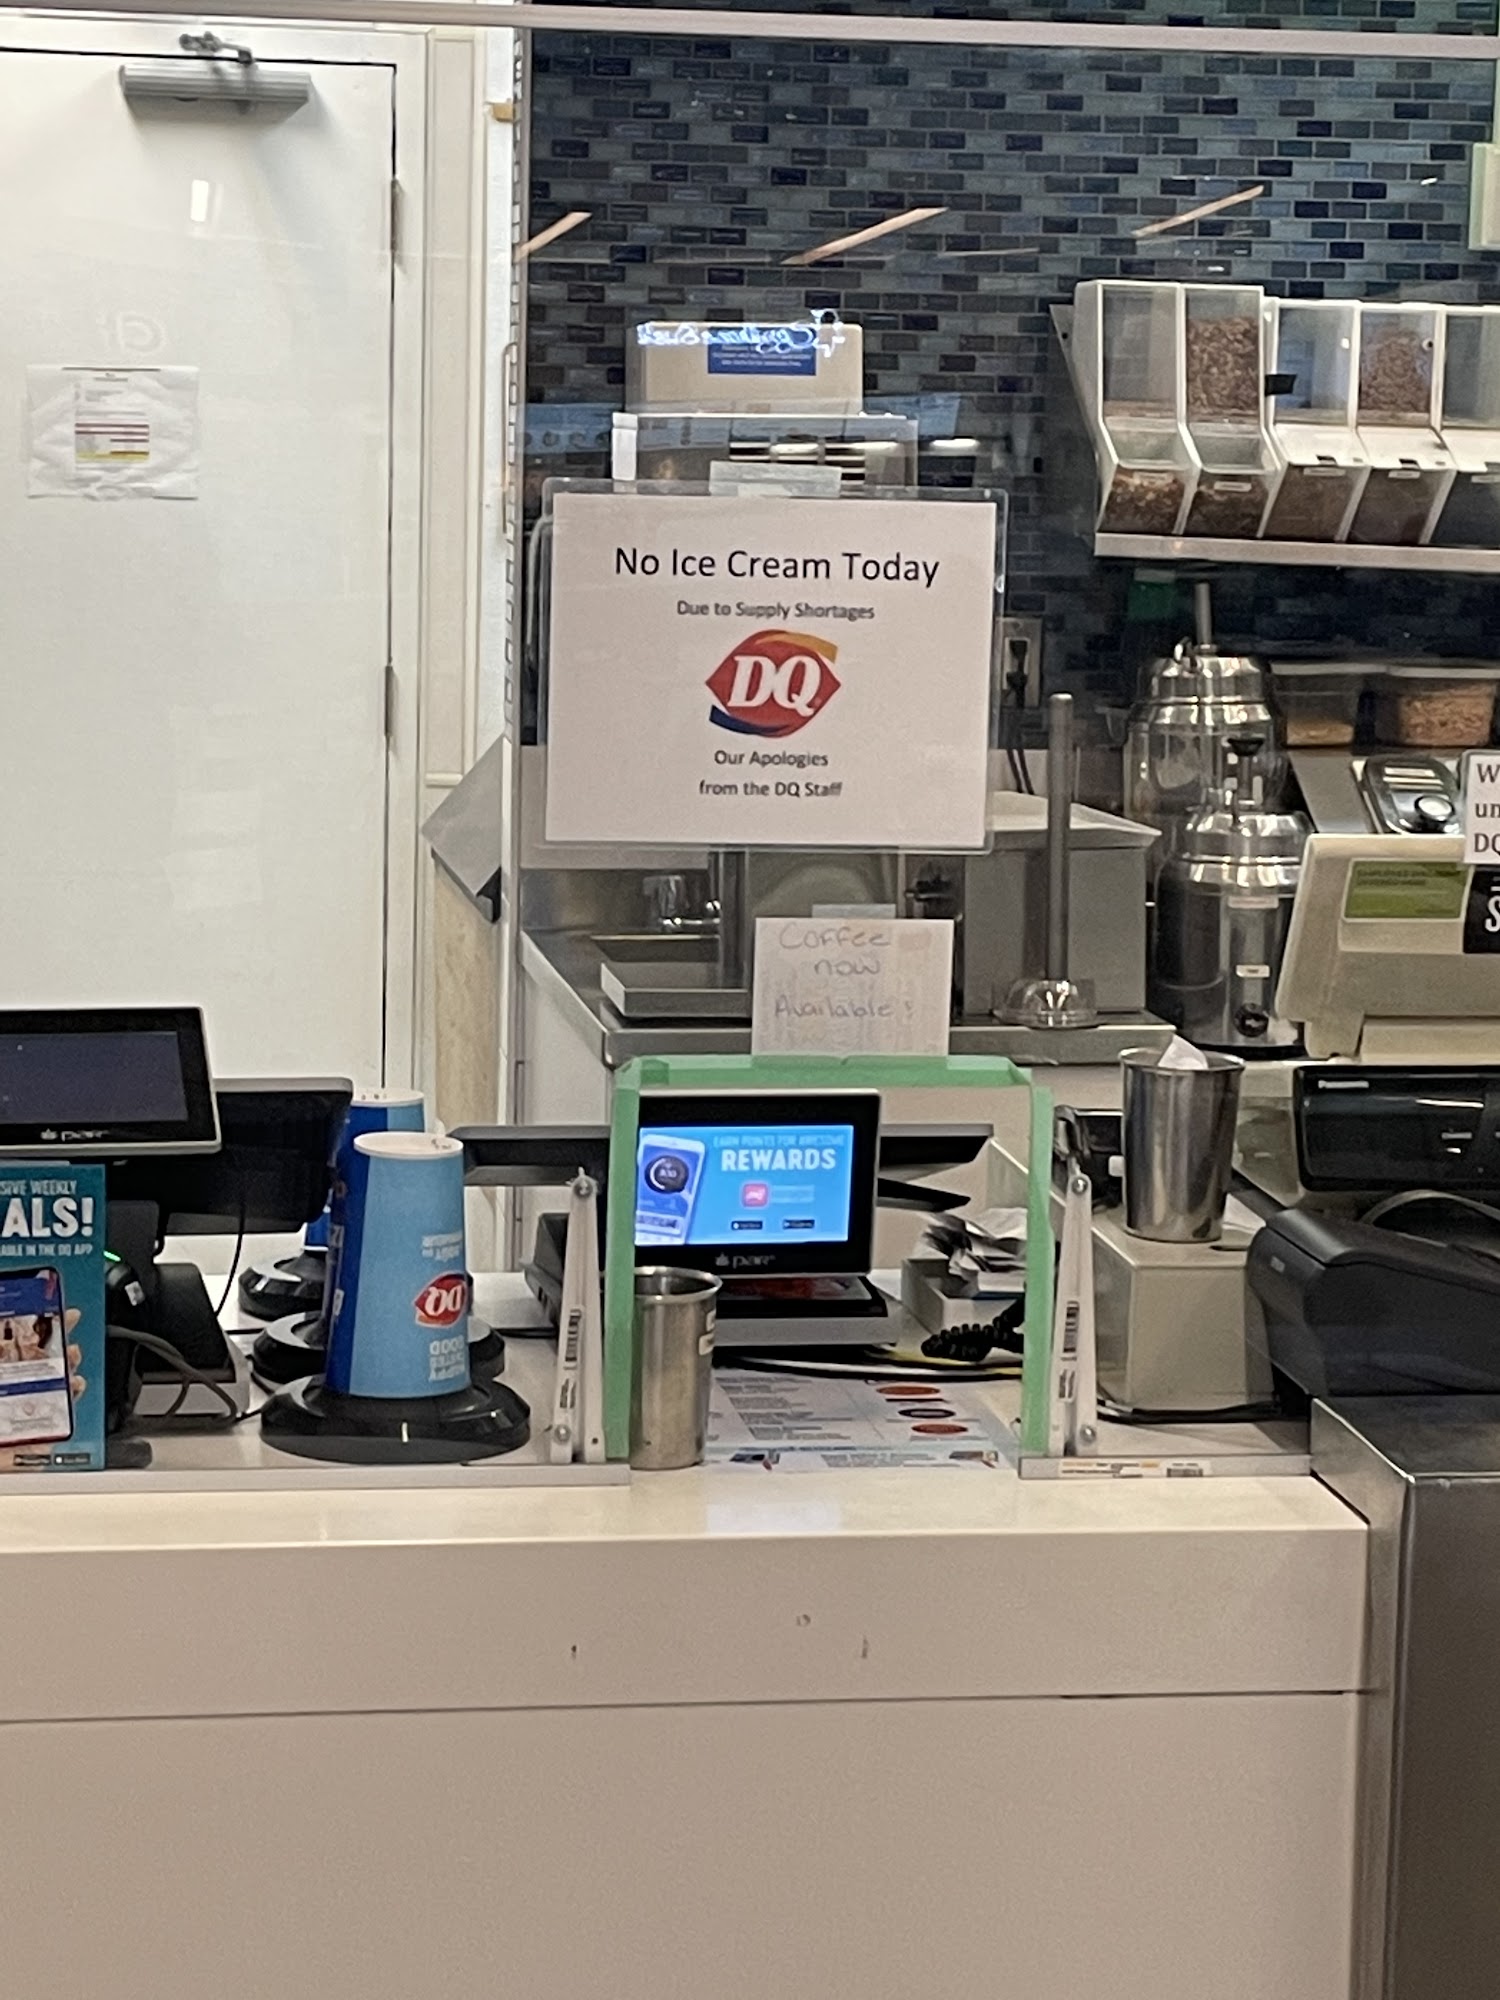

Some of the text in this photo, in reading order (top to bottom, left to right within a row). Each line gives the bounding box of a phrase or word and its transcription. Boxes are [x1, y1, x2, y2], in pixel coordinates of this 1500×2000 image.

[615, 547, 940, 588] No Ice Cream Today
[677, 600, 875, 622] Due to Supply Shortages
[726, 654, 822, 717] DQ
[714, 750, 829, 768] Our Apologies
[699, 780, 843, 798] from the DQ Staff
[779, 922, 891, 949] Coffee
[814, 958, 881, 976] now
[721, 1148, 836, 1171] REWARDS
[1, 1197, 94, 1238] ALS!
[425, 1284, 462, 1317] DQ
